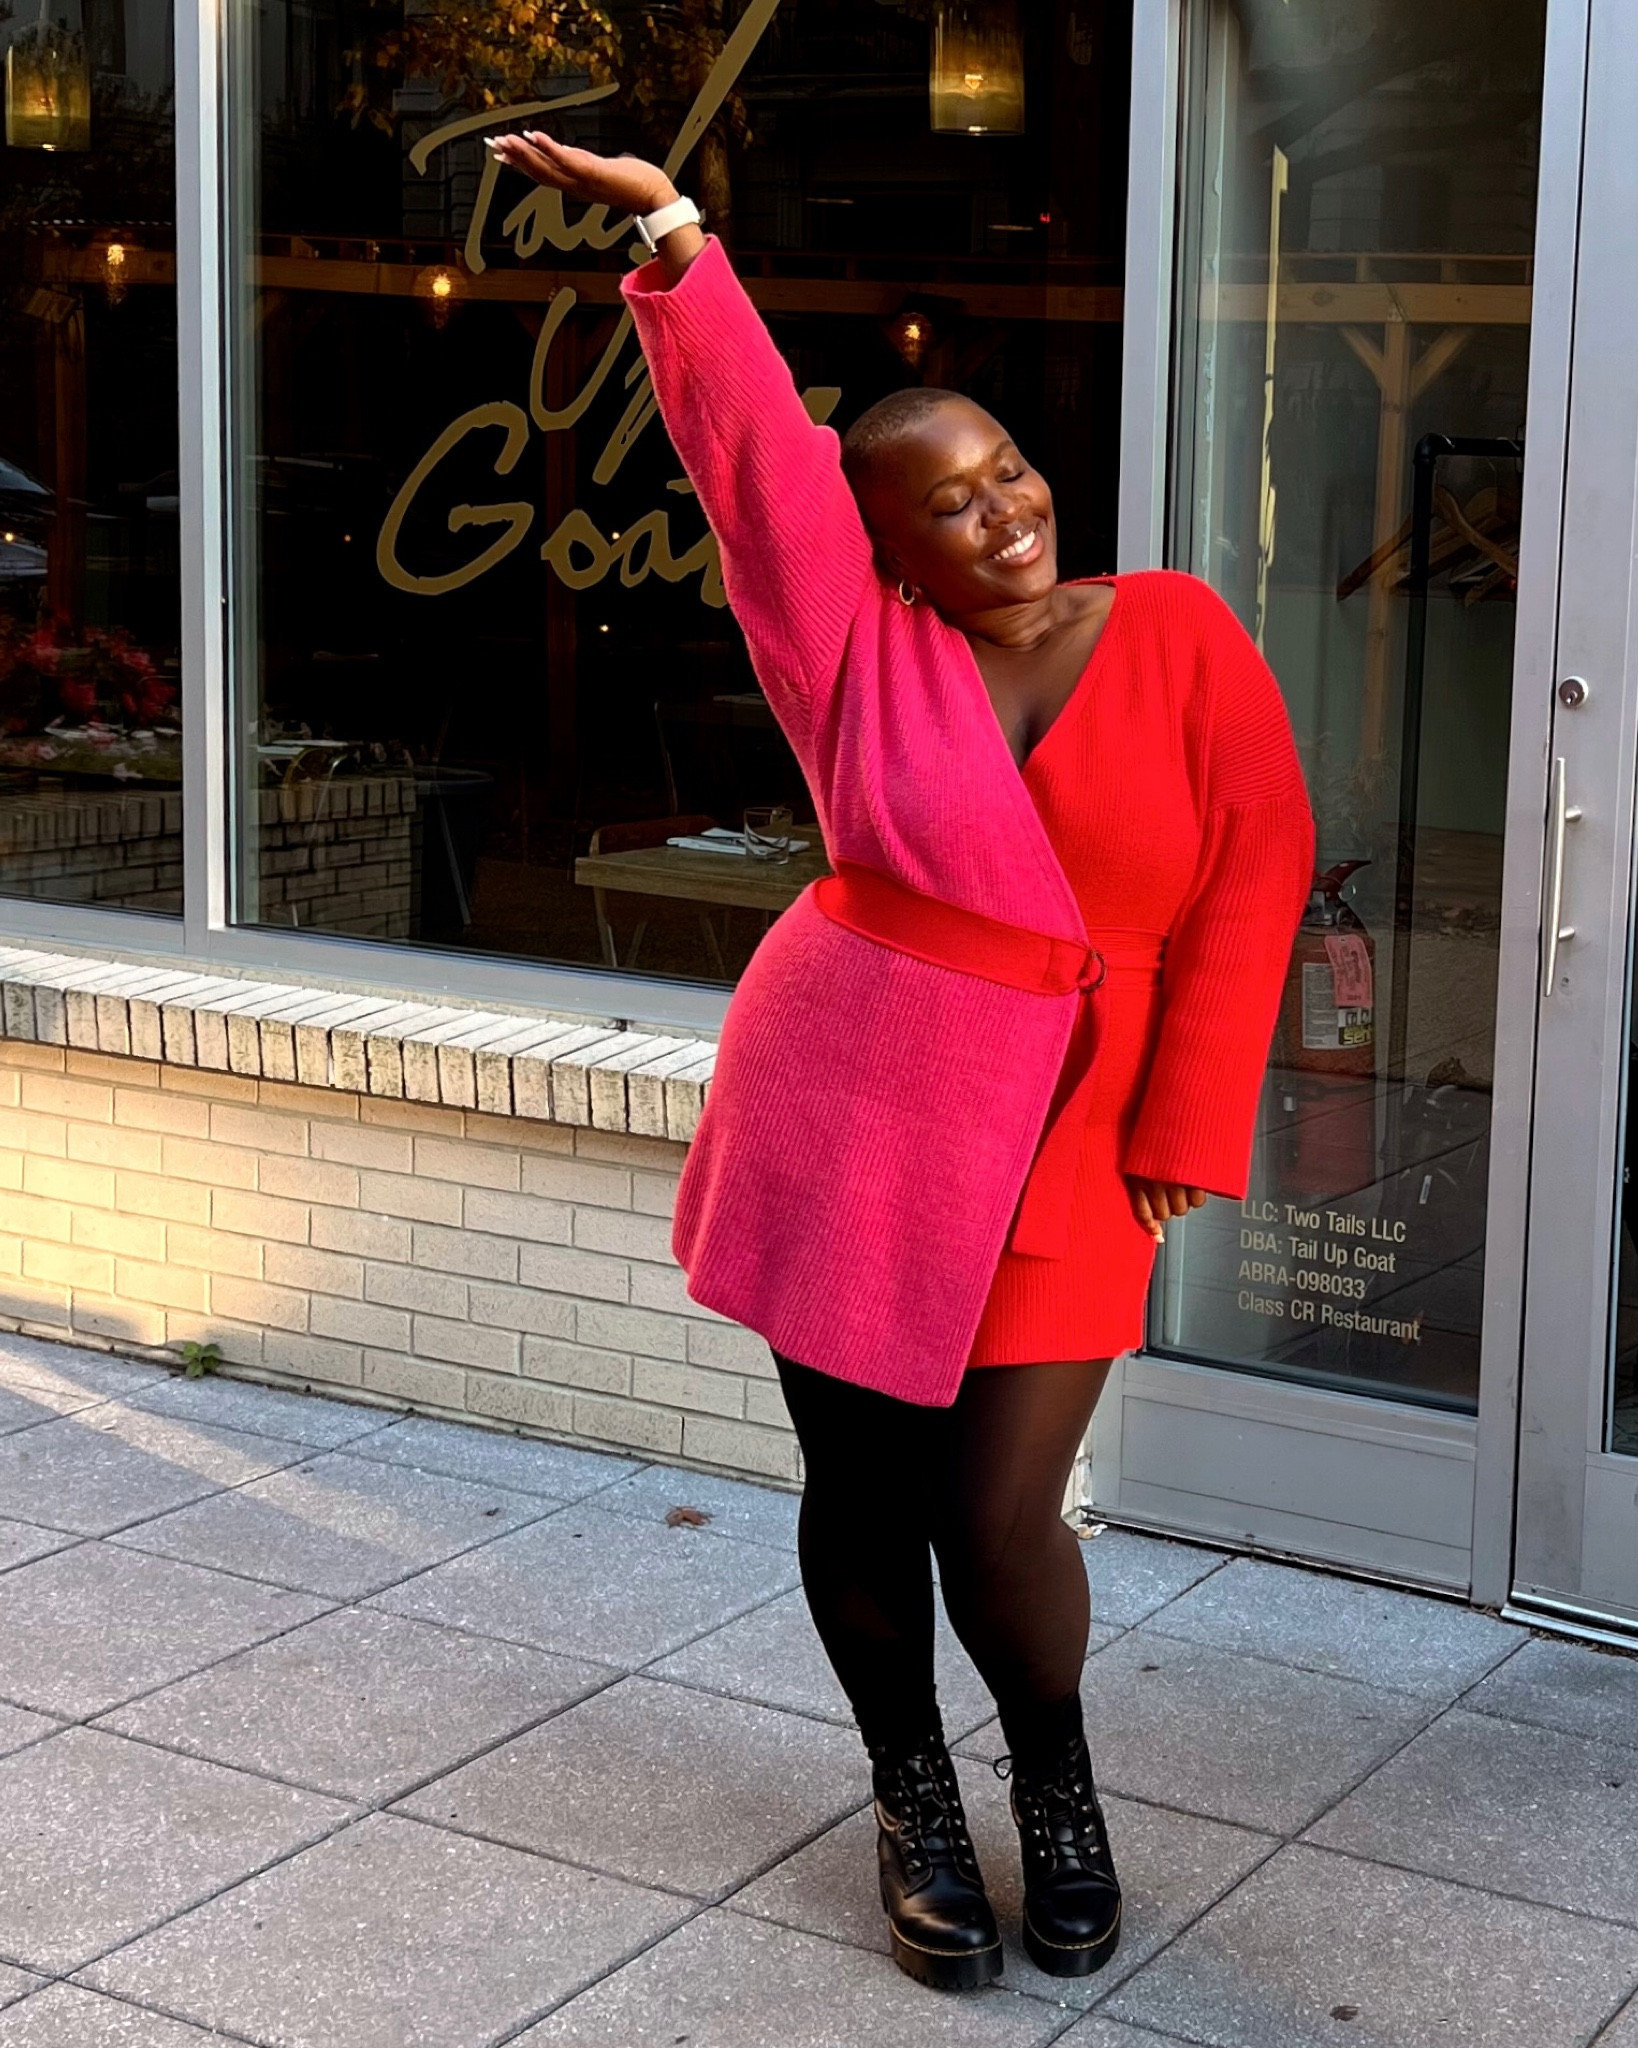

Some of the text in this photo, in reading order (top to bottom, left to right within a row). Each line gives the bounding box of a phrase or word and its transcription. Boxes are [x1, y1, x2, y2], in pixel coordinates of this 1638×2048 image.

[1241, 1200, 1406, 1243] LLC: Two Tails LLC
[1240, 1229, 1396, 1273] DBA: Tail Up Goat
[1238, 1260, 1366, 1299] ABRA-098033
[1238, 1290, 1421, 1341] Class CR Restaurant
